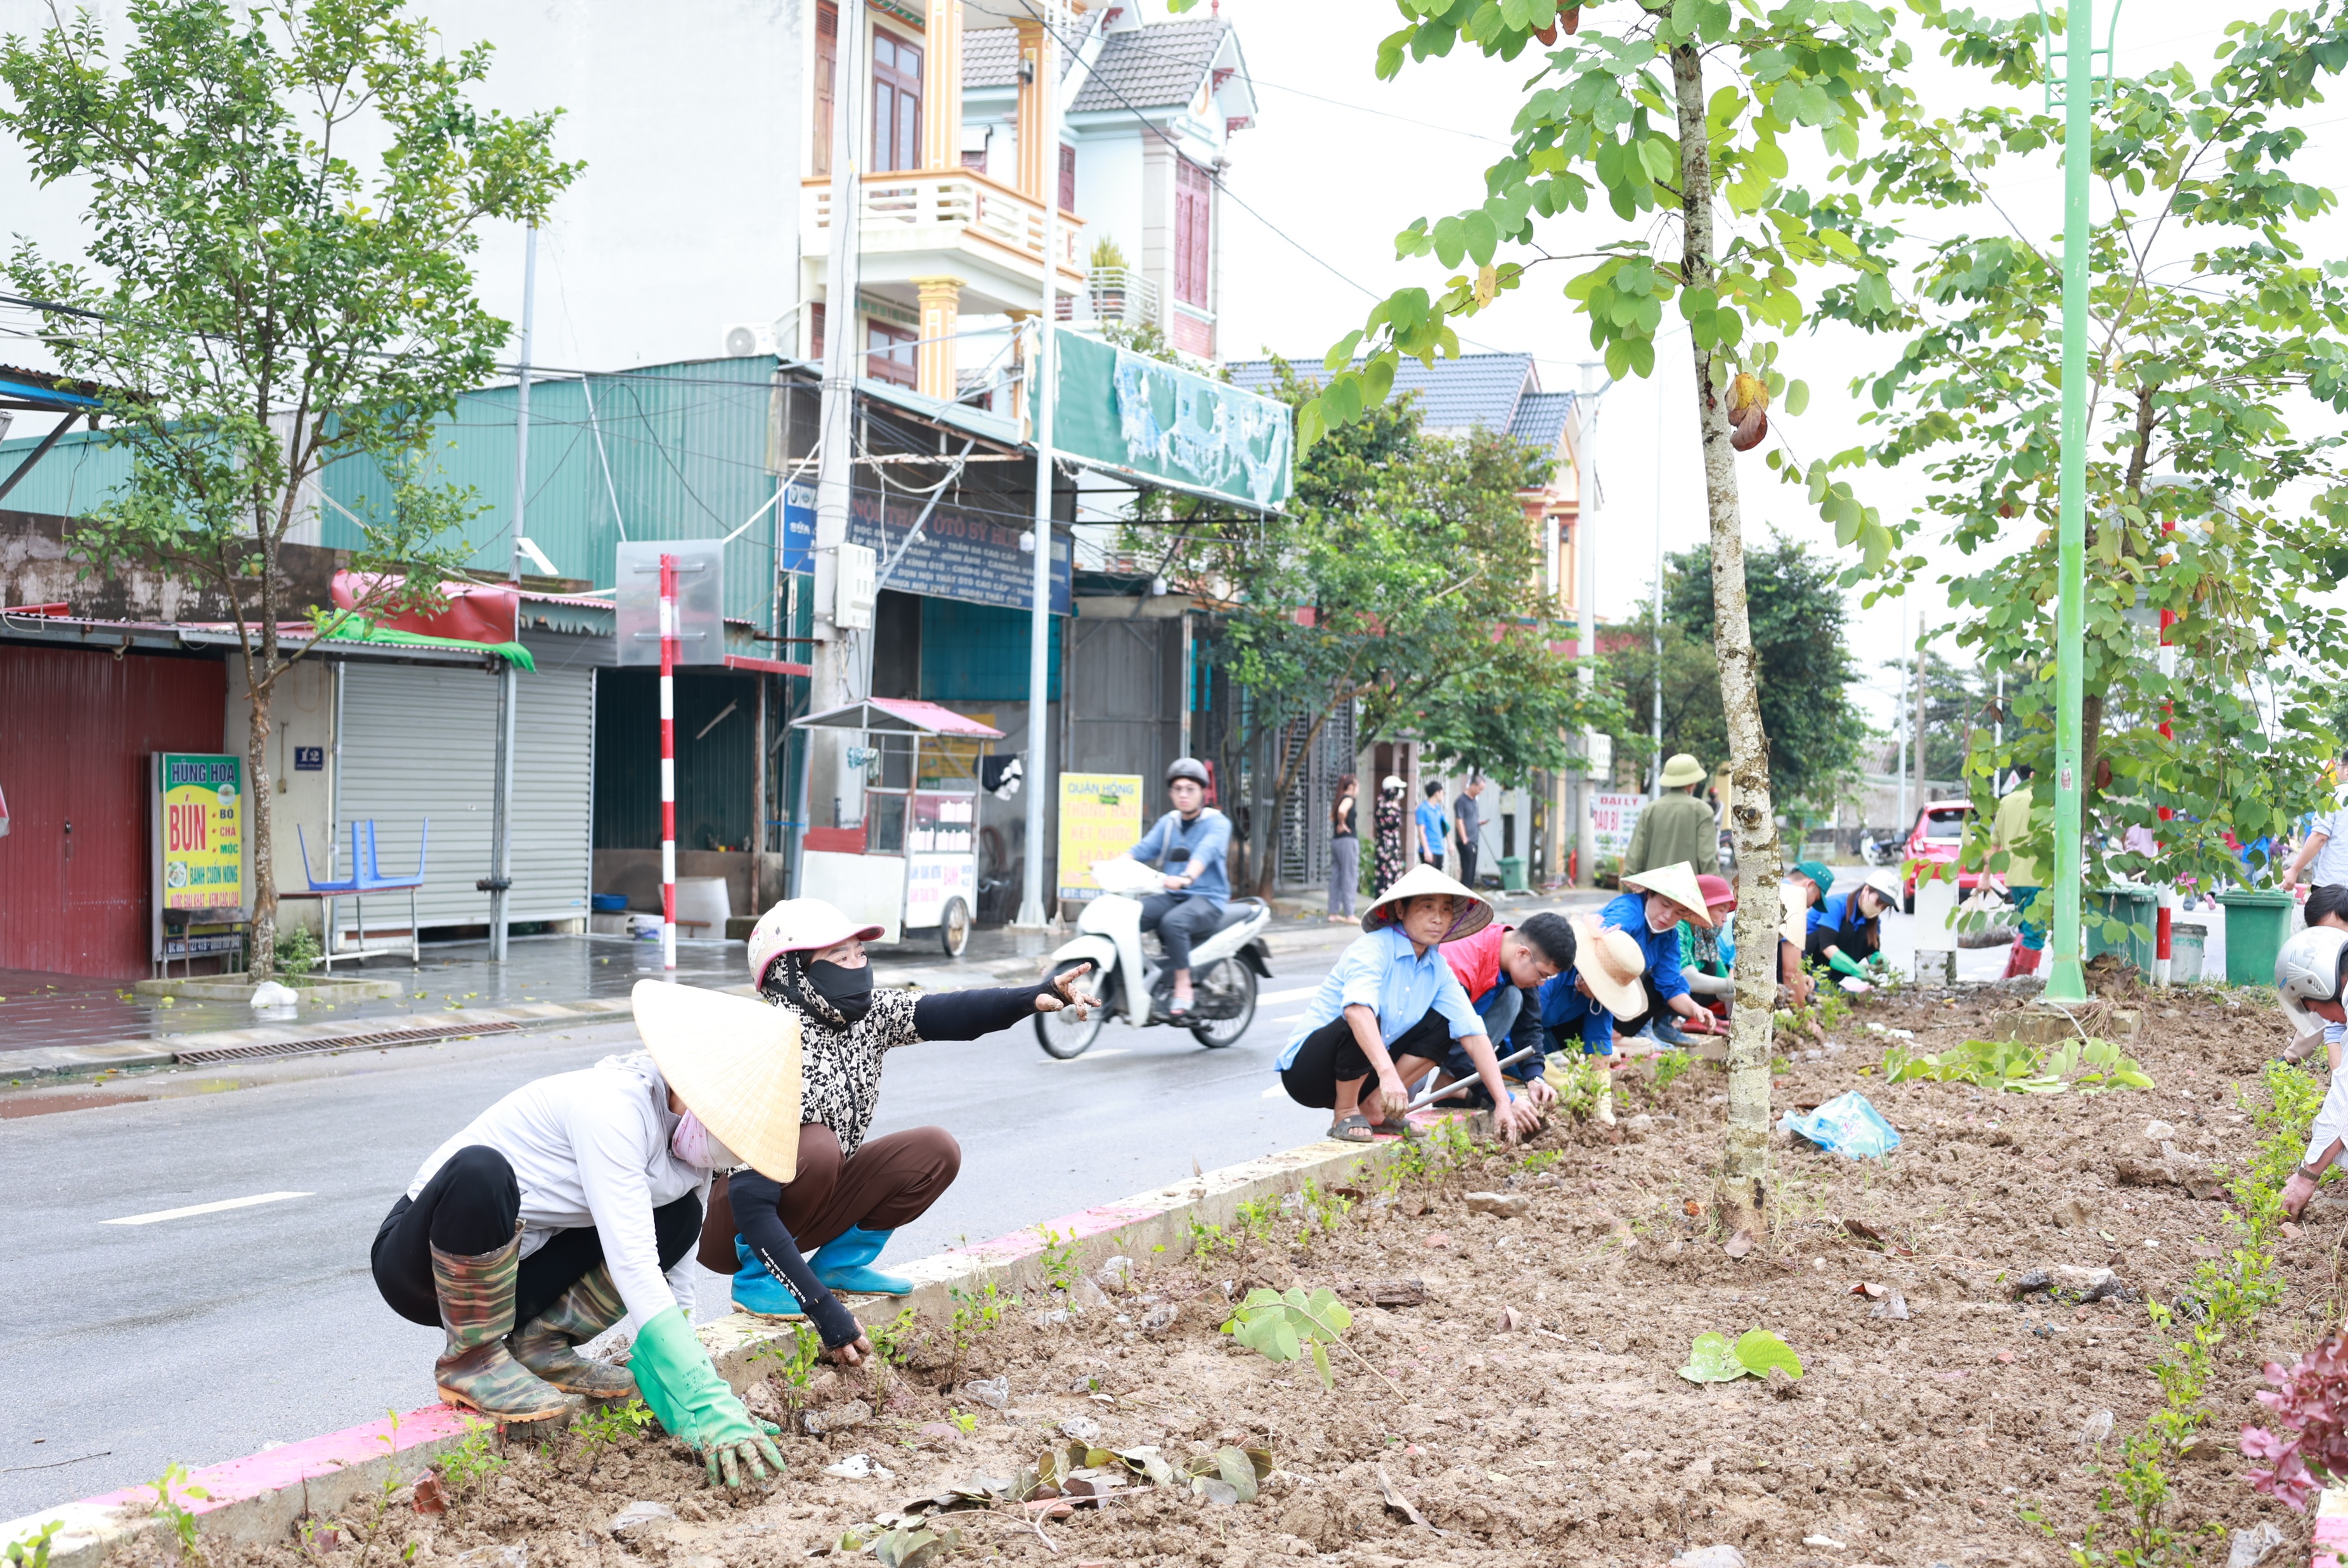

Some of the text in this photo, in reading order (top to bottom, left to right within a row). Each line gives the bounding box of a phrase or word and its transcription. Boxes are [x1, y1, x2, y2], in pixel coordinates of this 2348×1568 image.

[301, 748, 320, 762] 12
[171, 759, 236, 783] HÙNG HOA
[220, 807, 234, 819] BÒ
[169, 793, 206, 852] BÚN
[220, 823, 236, 836] CHẢ
[220, 842, 238, 856] MỘC
[190, 859, 238, 885] BÁNH CUỐN NÓNG
